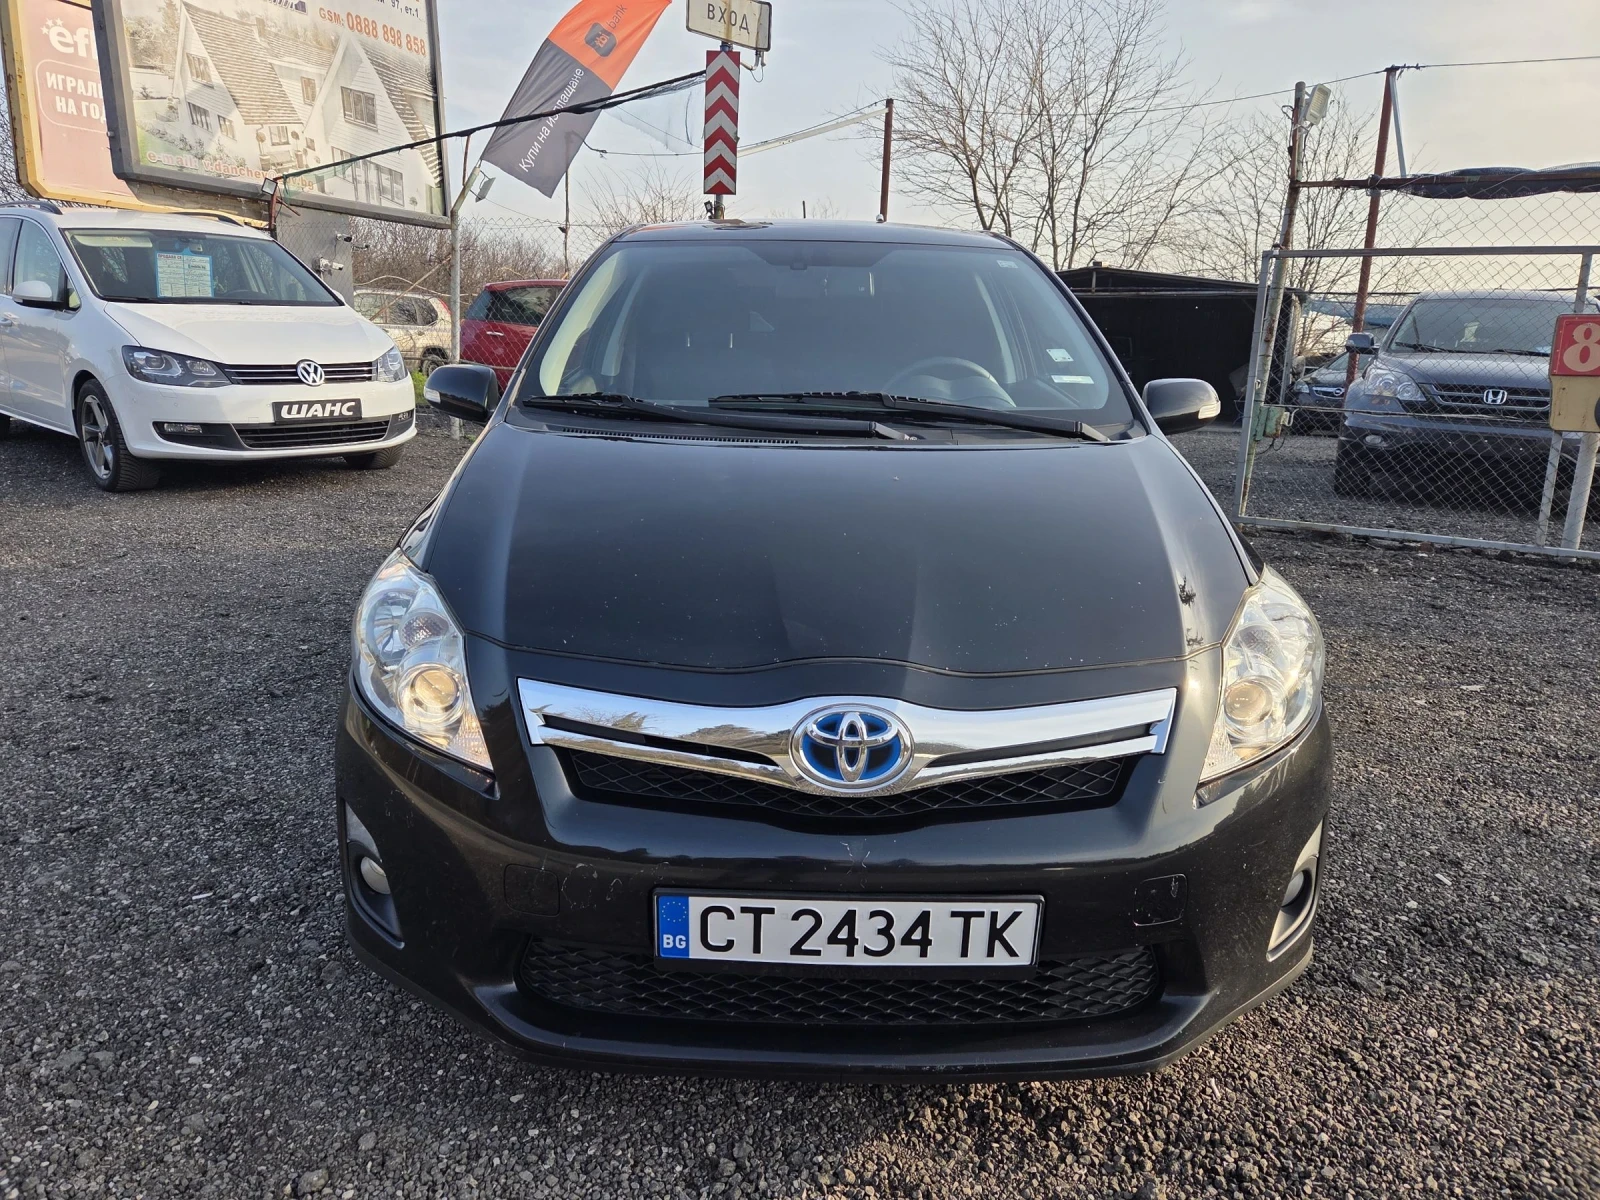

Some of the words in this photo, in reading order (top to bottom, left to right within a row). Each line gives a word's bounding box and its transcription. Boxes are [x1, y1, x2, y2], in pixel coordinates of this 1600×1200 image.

[606, 4, 628, 30] bank
[707, 3, 750, 35] ВХОД
[318, 7, 344, 26] GSM:
[346, 11, 378, 39] 0888
[382, 24, 403, 49] 898
[405, 33, 427, 57] 858
[55, 96, 77, 116] НА
[518, 141, 542, 172] Купи
[537, 126, 551, 143] на
[281, 402, 355, 418] ШАНС
[662, 934, 687, 949] BG
[700, 905, 775, 954] CT
[789, 908, 932, 958] 2434
[950, 910, 1023, 958] TK
